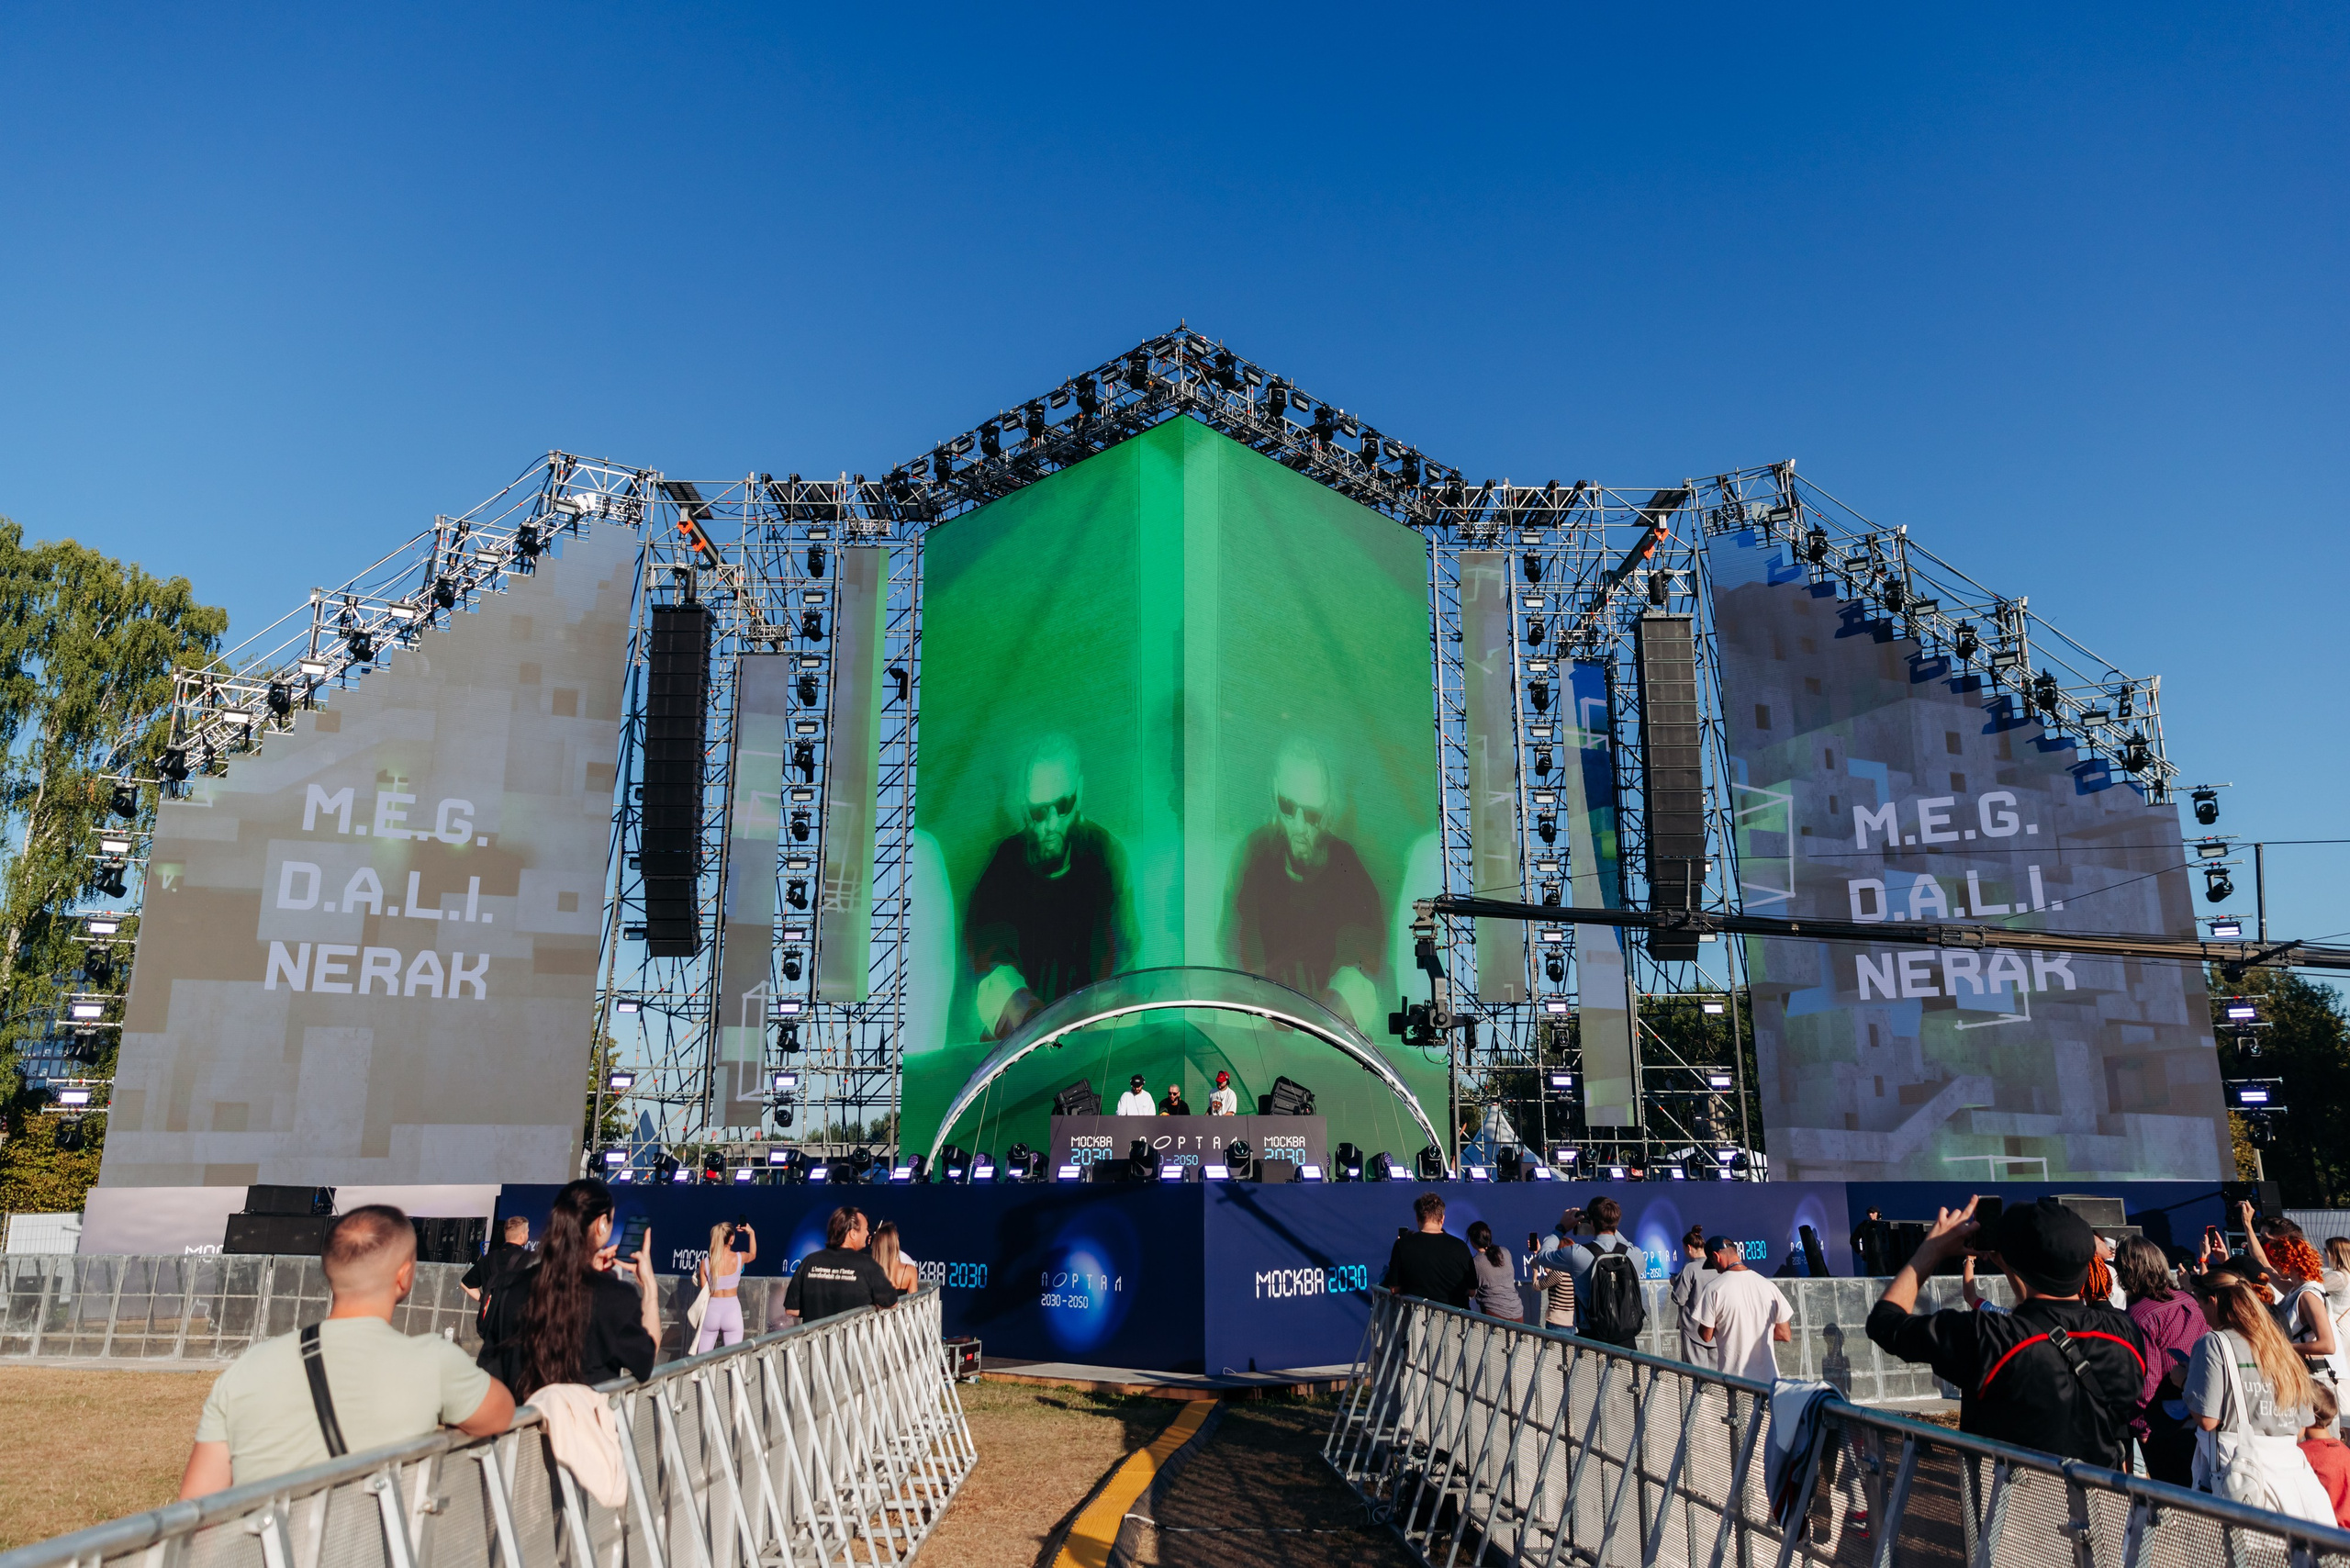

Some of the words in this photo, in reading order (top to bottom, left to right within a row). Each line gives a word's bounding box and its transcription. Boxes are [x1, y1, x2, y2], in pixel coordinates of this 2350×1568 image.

[302, 784, 489, 847] M.E.G.
[1852, 790, 2039, 850] M.E.G.
[275, 861, 494, 924] D.A.L.I.
[1848, 865, 2065, 924] D.A.L.I.
[263, 940, 490, 1001] NERAK
[1855, 947, 2076, 1001] NERAK
[1070, 1136, 1113, 1148] МОСКВА
[1263, 1136, 1305, 1148] МОСКВА
[1745, 1240, 1767, 1260] 2030
[949, 1262, 988, 1288] 2030
[1041, 1271, 1122, 1293] ПОРТАЛ
[1256, 1268, 1325, 1299] МОСКВА
[1328, 1264, 1367, 1293] 2030
